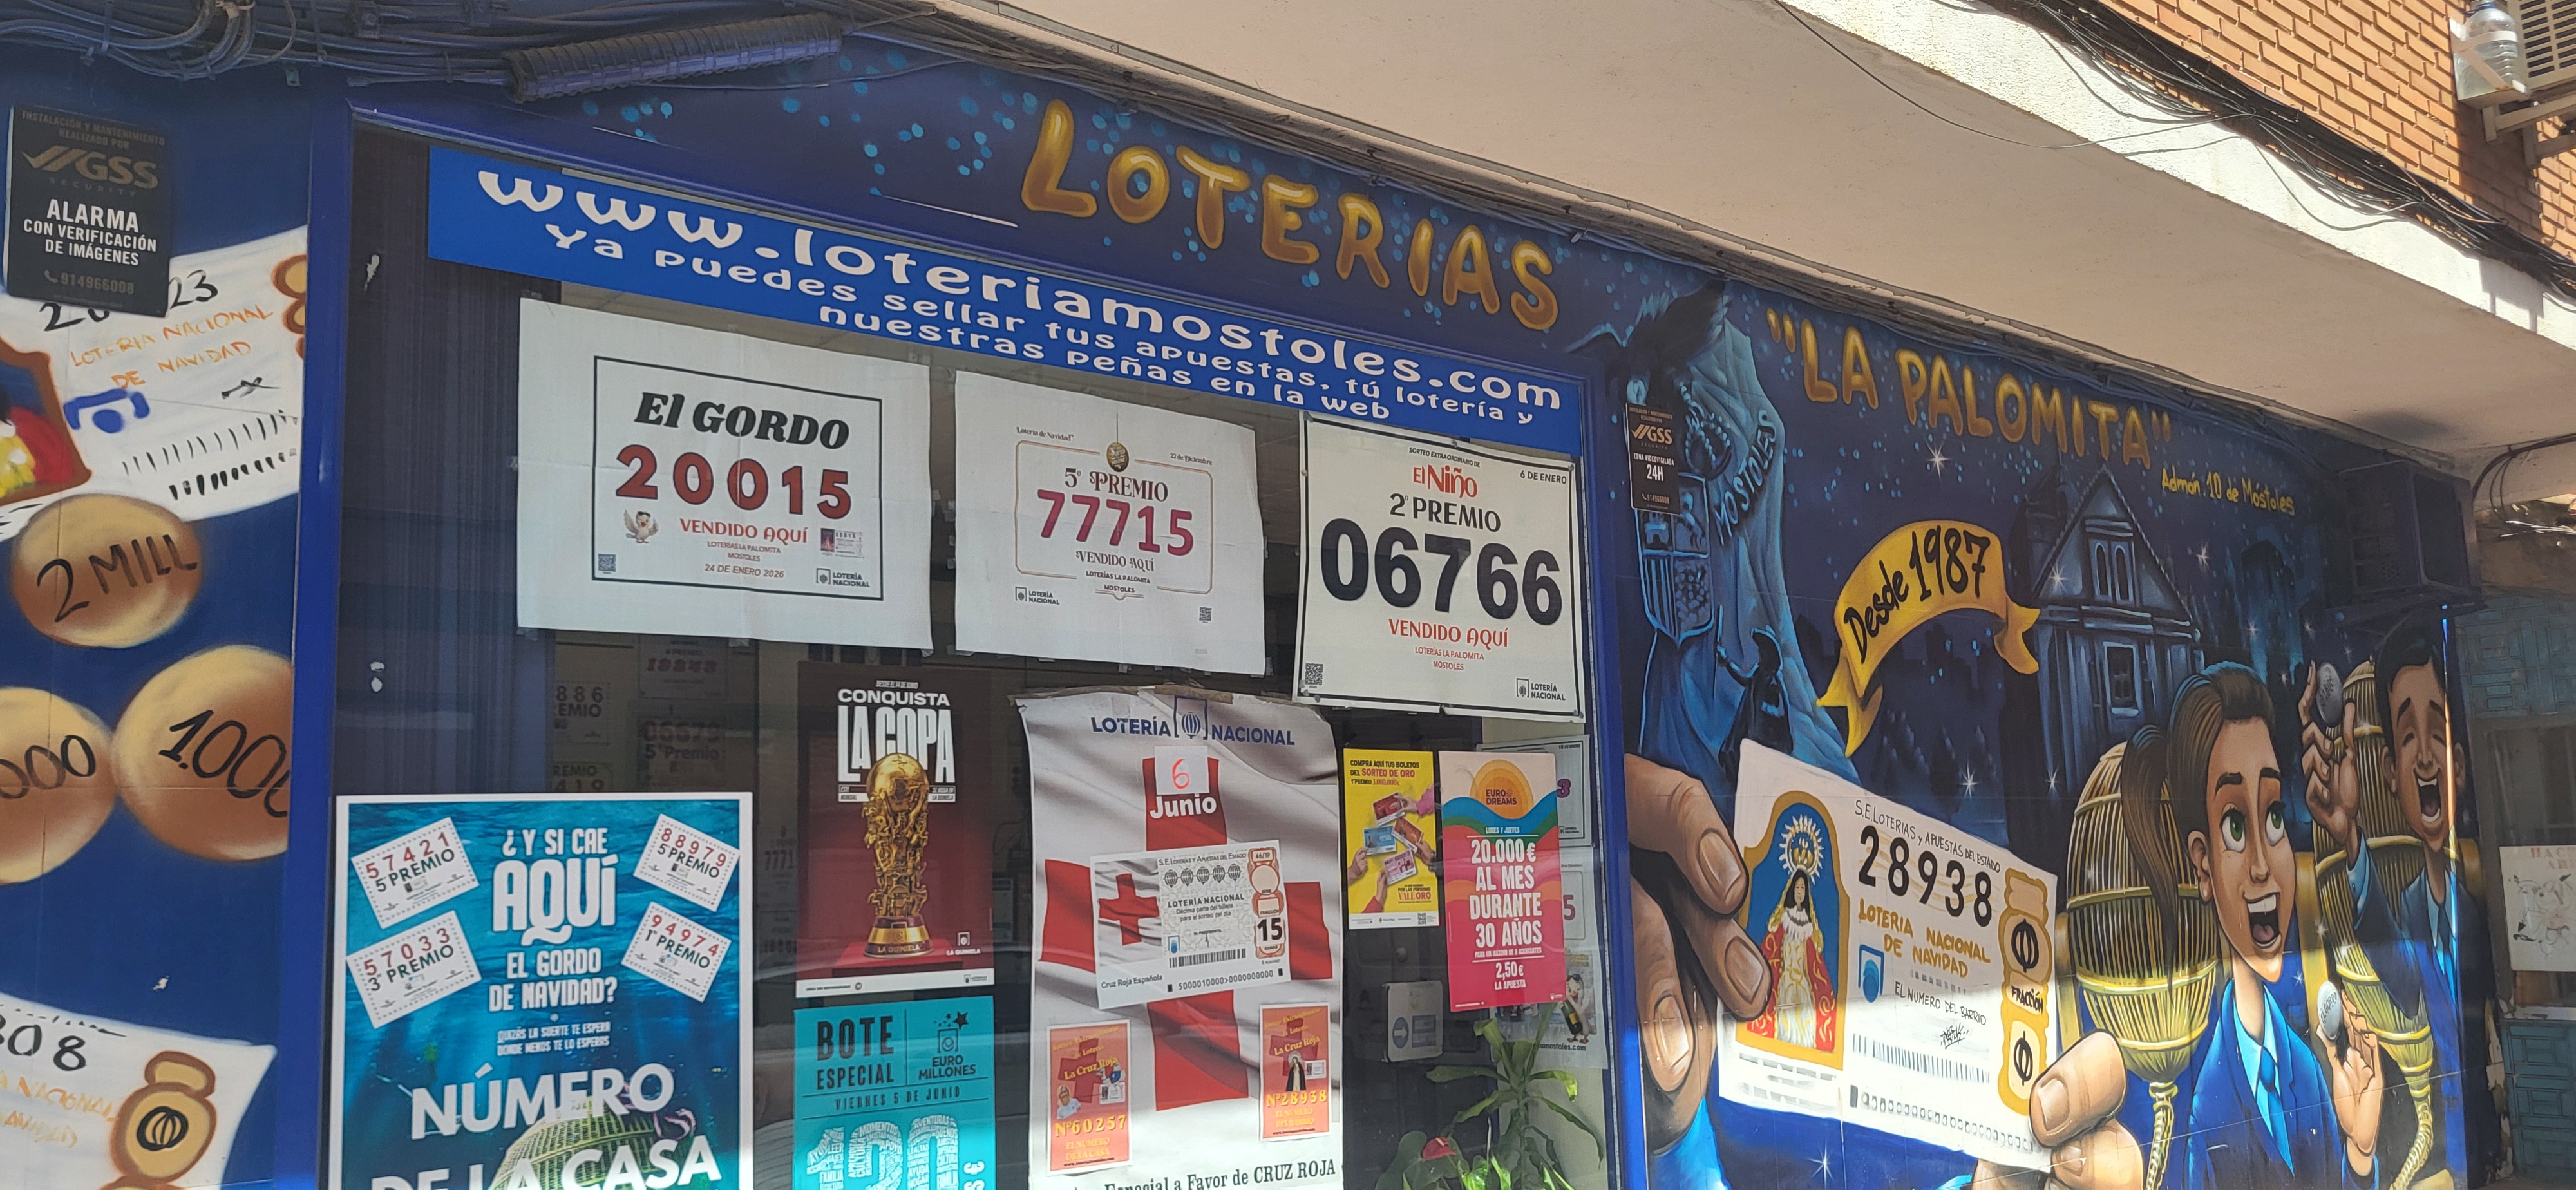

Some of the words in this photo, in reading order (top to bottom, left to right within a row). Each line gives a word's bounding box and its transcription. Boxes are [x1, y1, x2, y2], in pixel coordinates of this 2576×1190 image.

[75, 151, 159, 189] GSS
[46, 199, 139, 233] ALARMA
[1022, 99, 1559, 330] LOTERIAS
[23, 218, 53, 236] CON
[58, 224, 156, 252] VERIFICACIÓN
[45, 239, 63, 254] DE
[69, 242, 139, 266] IMÁGENES
[61, 272, 135, 294] 914966008
[478, 170, 1560, 410] www.loteriamostoles.com
[163, 304, 274, 341] NACIONAL
[545, 224, 623, 259] Ya
[654, 249, 857, 302] puedes
[884, 294, 1025, 332] sellar
[1045, 322, 1115, 350] tus
[1346, 379, 1379, 399] tú
[1397, 386, 1504, 420] lotería
[1518, 411, 1533, 424] y
[111, 370, 145, 388] DE
[157, 341, 251, 373] NAVIDAD
[820, 306, 1045, 359] nuestras
[1066, 356, 1192, 385] peñas
[1211, 377, 1255, 396] en
[1274, 384, 1304, 406] la
[1321, 395, 1390, 419] web
[634, 392, 685, 428] El
[693, 401, 849, 449] GORDO
[1647, 428, 1672, 444] GSS
[1409, 447, 1430, 457] SORTEO
[1430, 450, 1473, 467] EXTRAORDINARIO
[1645, 454, 1674, 466] VIDEOVIGILADA
[616, 444, 851, 519] 20015
[1090, 471, 1168, 502] PREMIO
[1427, 464, 1478, 498] Niño
[1520, 470, 1525, 478] 6
[1527, 471, 1538, 481] DE
[1540, 473, 1567, 484] ENERO
[1647, 464, 1663, 482] 24H
[1714, 409, 1777, 546] MOSTOLES
[2206, 471, 2221, 499] 10
[2227, 477, 2239, 502] de
[2242, 477, 2295, 516] Móstoles
[1037, 489, 1194, 556] 77715
[1413, 496, 1501, 532] PREMIO
[680, 518, 757, 538] VENDIDO
[764, 527, 808, 545] AQUÍ
[717, 565, 730, 573] DE
[733, 566, 761, 576] ENERO
[764, 570, 784, 578] 2026
[833, 572, 862, 580] LOTERÍA
[1076, 550, 1126, 567] VENDIDO
[1129, 558, 1155, 572] AQUÍ
[1320, 518, 1562, 626] 06766
[37, 558, 90, 623] 2
[89, 534, 198, 594] MILL
[1104, 584, 1135, 593] MOSTOLES
[1122, 575, 1150, 583] PALOMITA
[1843, 560, 1910, 664] Desde
[1908, 525, 1991, 603] 1987
[1388, 618, 1461, 643] VENDIDO
[1466, 628, 1508, 650] AQUÍ
[1415, 646, 1441, 656] LOTERÍAS
[1443, 648, 1450, 657] LA
[1451, 650, 1484, 661] PALOMITA
[1433, 661, 1464, 670] MOSTOLES
[838, 689, 951, 706] CONQUISTA
[1531, 683, 1557, 693] LOTERÍA
[1531, 691, 1566, 701] NACIONAL
[838, 705, 871, 782] LA
[876, 707, 955, 783] COPA
[1090, 716, 1171, 737] LOTERÍA
[1211, 724, 1295, 746] NACIONAL
[1171, 758, 1189, 789] 6
[1361, 768, 1387, 777] SORTEO
[1149, 793, 1217, 819] Junio
[366, 832, 449, 879] 57421
[544, 829, 564, 855] SI
[572, 827, 608, 855] CAE
[661, 828, 726, 867] 88979
[1471, 839, 1524, 864] 20.000
[1527, 842, 1536, 862] €
[1925, 833, 1964, 857] APUESTAS
[1965, 848, 1975, 862] DEL
[1977, 853, 2000, 873] ESTADO
[388, 848, 455, 886] PREMIO
[668, 847, 720, 878] PREMIO
[1476, 867, 1497, 891] AL
[1502, 865, 1535, 890] MES
[1859, 825, 1992, 927] 28938
[493, 854, 618, 946] AQUÍ
[1168, 898, 1203, 908] LOTERÍA
[1204, 894, 1244, 904] NACIONAL
[1470, 892, 1542, 920] DURANTE
[651, 914, 720, 957] 94974
[1258, 917, 1283, 941] 15
[1475, 923, 1495, 948] 30
[1502, 918, 1542, 947] AÑOS
[1859, 898, 1913, 938] LOTERIA
[1927, 927, 1991, 963] NACIONAL
[365, 927, 450, 976] 57033
[386, 944, 454, 983] PREMIO
[507, 952, 528, 979] EL
[536, 948, 601, 977] GORDO
[656, 935, 710, 968] PREMIO
[1884, 934, 1903, 957] DE
[1913, 945, 1968, 978] NAVIDAD
[1117, 978, 1132, 987] Roja
[1133, 974, 1163, 985] Española
[1495, 981, 1501, 990] LA
[1496, 961, 1517, 980] 2,50
[1518, 965, 1524, 976] €
[489, 984, 515, 1012] DE
[522, 976, 618, 1010] NAVIDAD?
[1895, 981, 1906, 999] EL
[1908, 987, 1941, 1009] NUMERO
[1945, 1000, 1958, 1014] DEL
[1960, 1006, 1986, 1026] BARRIO
[817, 1015, 895, 1061] BOTE
[1274, 1046, 1283, 1055] La
[1284, 1040, 1303, 1050] Cruz
[817, 1062, 894, 1090] ESPECIAL
[919, 1064, 976, 1080] MILLONES
[933, 1055, 963, 1067] EURO
[1064, 1070, 1075, 1081] La
[1076, 1063, 1097, 1075] Cruz
[412, 1062, 675, 1140] NÚMERO
[836, 1094, 886, 1111] VIERNES
[894, 1093, 898, 1103] 5
[906, 1090, 918, 1102] DE
[926, 1086, 960, 1100] JUNIO
[562, 1135, 722, 1190] CASA
[1188, 1173, 1227, 1189] Favor
[1233, 1169, 1248, 1185] de
[1254, 1163, 1293, 1183] CRUZ
[1297, 1159, 1336, 1178] ROJA
